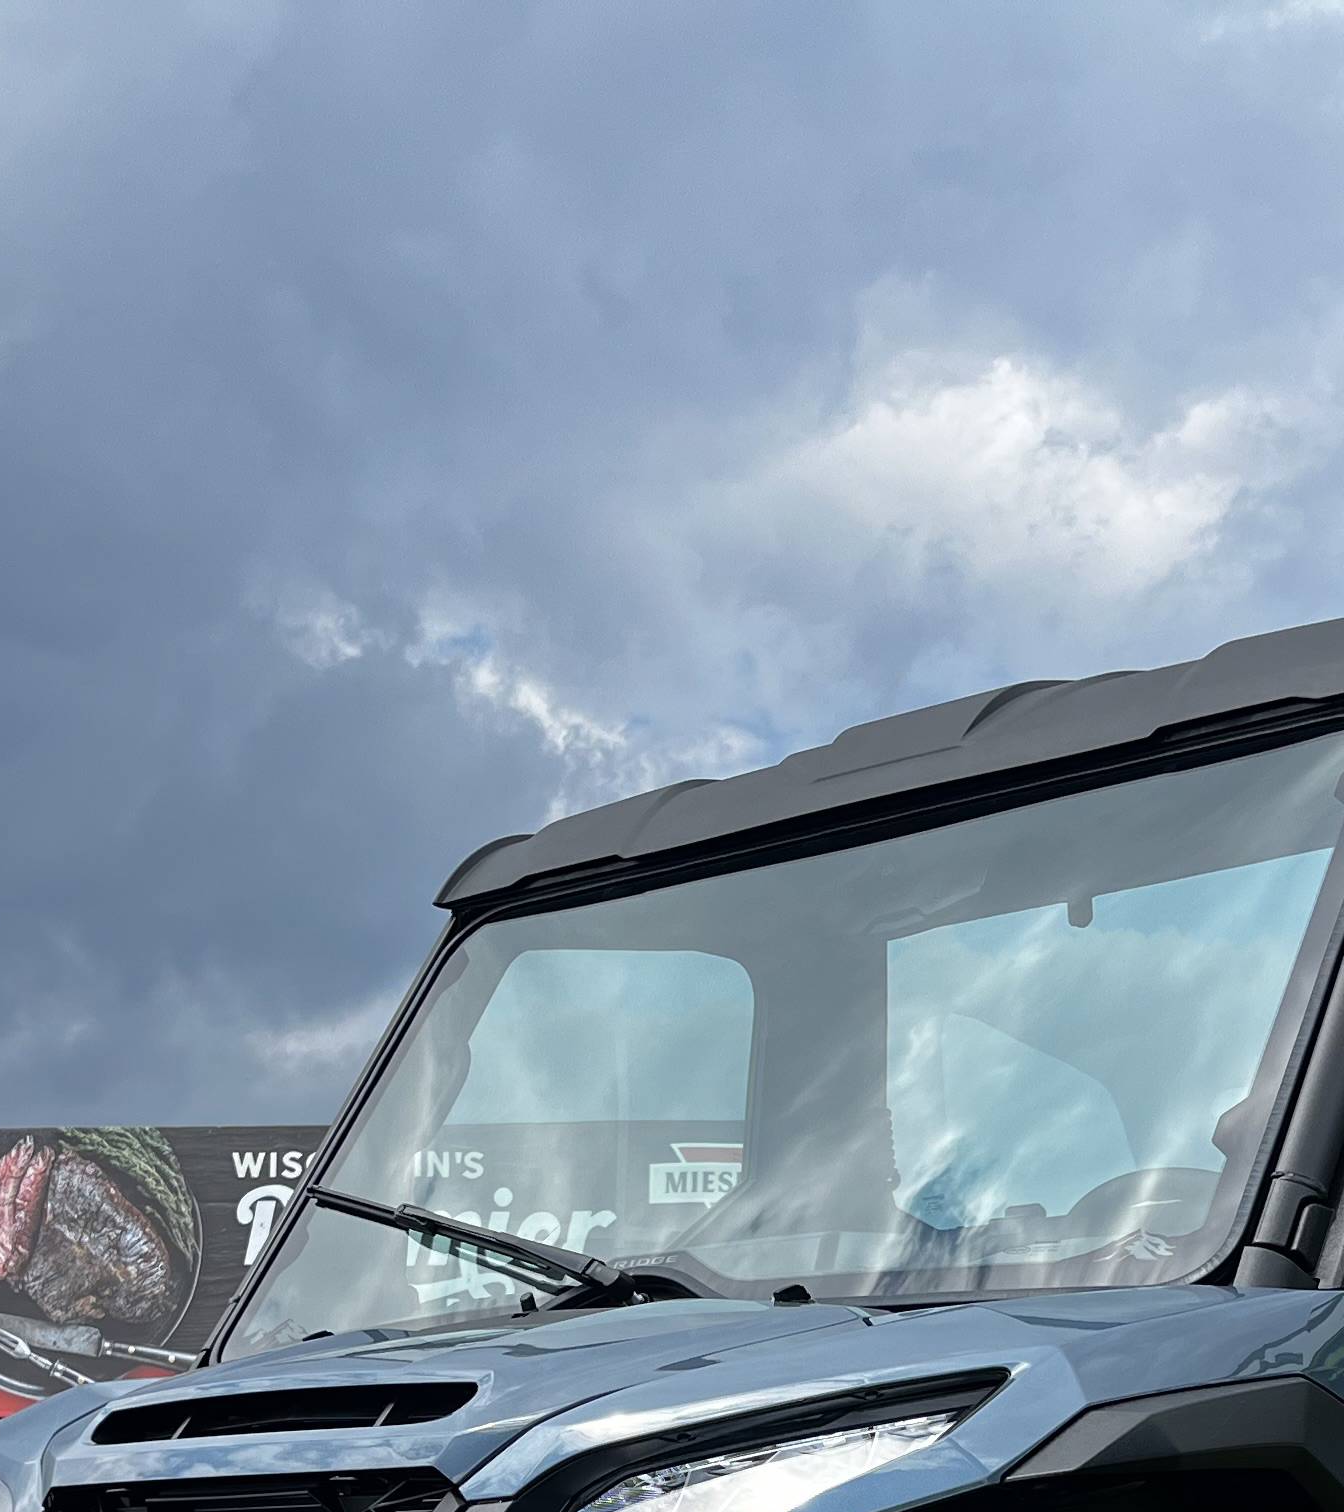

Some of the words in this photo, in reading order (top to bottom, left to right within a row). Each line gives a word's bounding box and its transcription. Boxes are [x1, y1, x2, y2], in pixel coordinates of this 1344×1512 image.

[232, 1150, 484, 1179] WISIN'S
[665, 1171, 741, 1194] MIES
[614, 1255, 678, 1269] RIDGE
